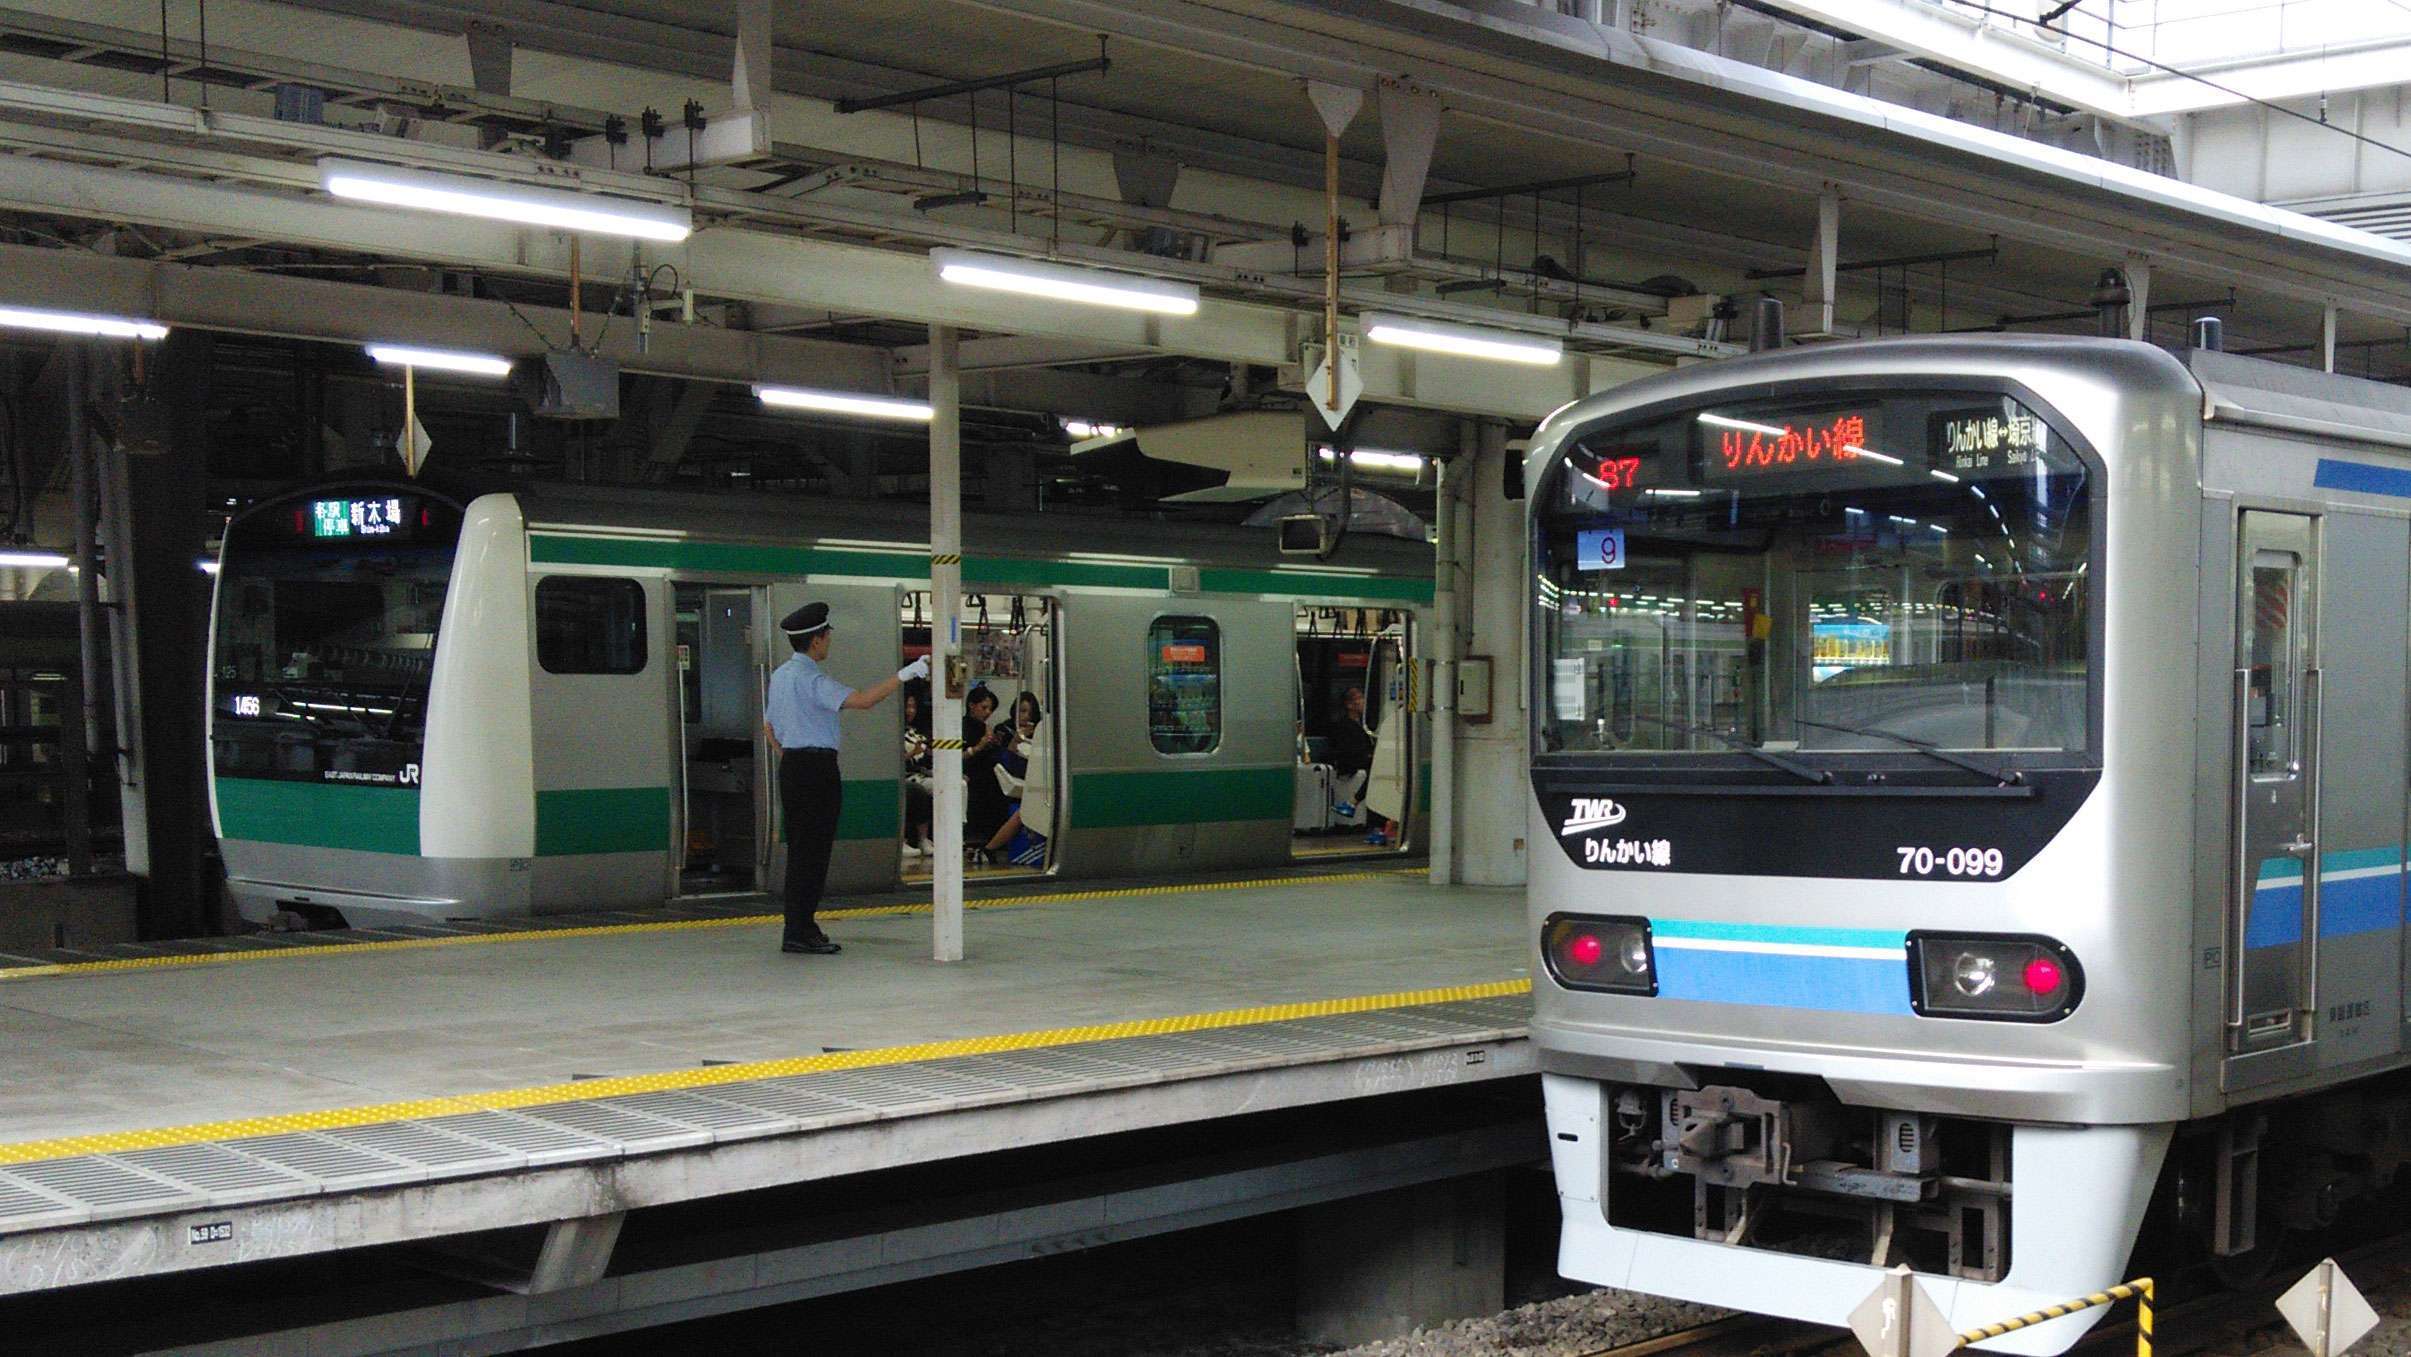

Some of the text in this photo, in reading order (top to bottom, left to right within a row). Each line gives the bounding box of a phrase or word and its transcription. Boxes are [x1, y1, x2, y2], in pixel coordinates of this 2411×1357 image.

[1721, 416, 1866, 468] りんかい線
[1600, 457, 1640, 488] 87
[350, 499, 401, 526] 新木場
[1601, 536, 1617, 564] 9
[400, 763, 419, 784] JR
[1585, 838, 1671, 867] りんかい線
[1897, 847, 2004, 877] 70-099
